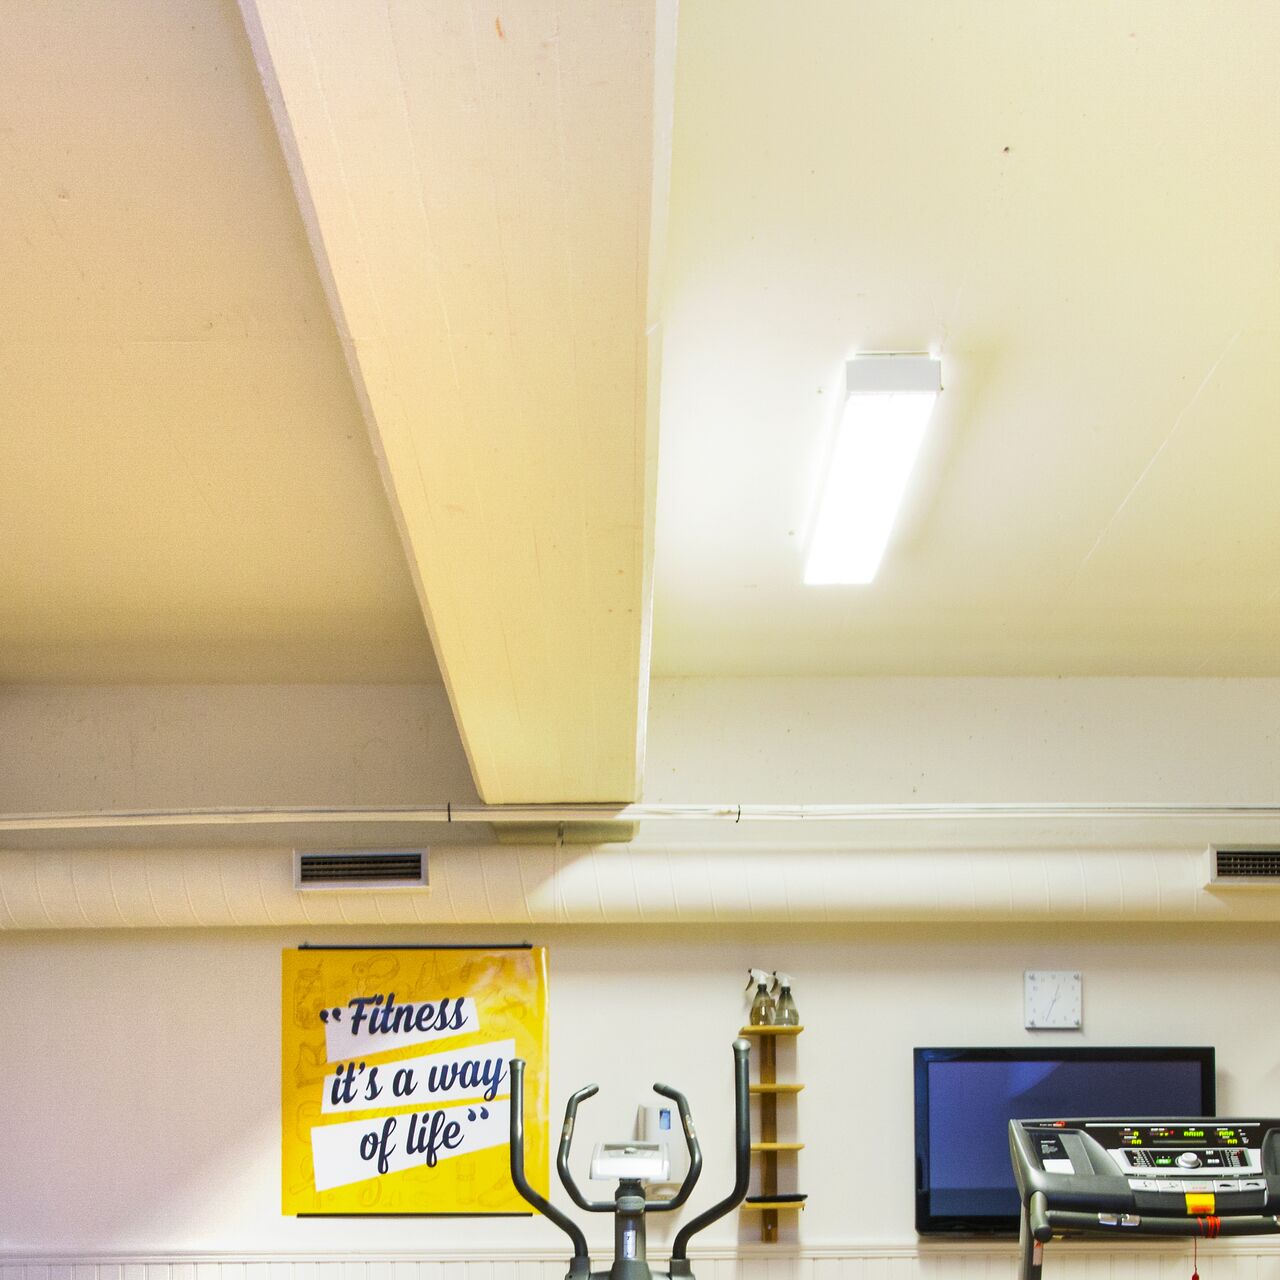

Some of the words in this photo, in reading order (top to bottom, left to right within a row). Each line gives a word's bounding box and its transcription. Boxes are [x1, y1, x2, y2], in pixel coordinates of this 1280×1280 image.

[331, 1062, 382, 1105] it's
[392, 1067, 418, 1097] a
[427, 1057, 508, 1101] way
[360, 1116, 397, 1174] of
